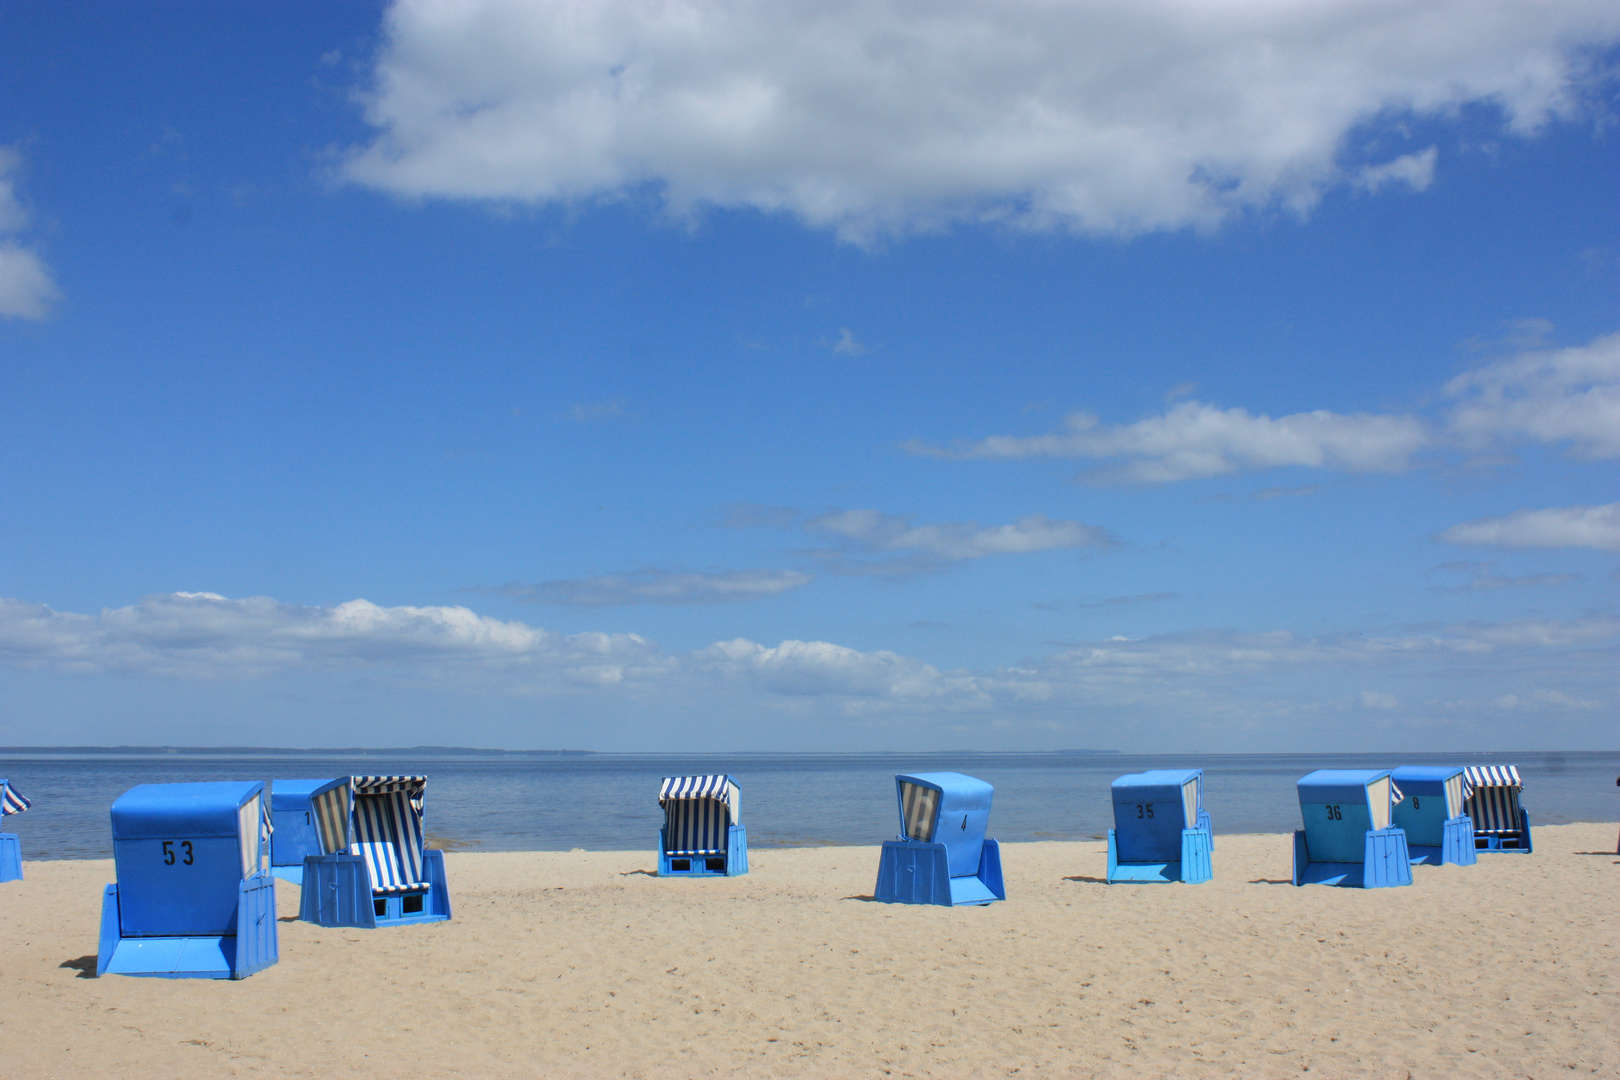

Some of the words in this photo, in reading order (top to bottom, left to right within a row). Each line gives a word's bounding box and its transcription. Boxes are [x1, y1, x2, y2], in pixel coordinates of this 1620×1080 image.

[1136, 803, 1154, 819] 35
[1412, 796, 1420, 810] 8
[304, 811, 310, 826] 1
[1325, 804, 1342, 820] 36
[162, 840, 194, 866] 53
